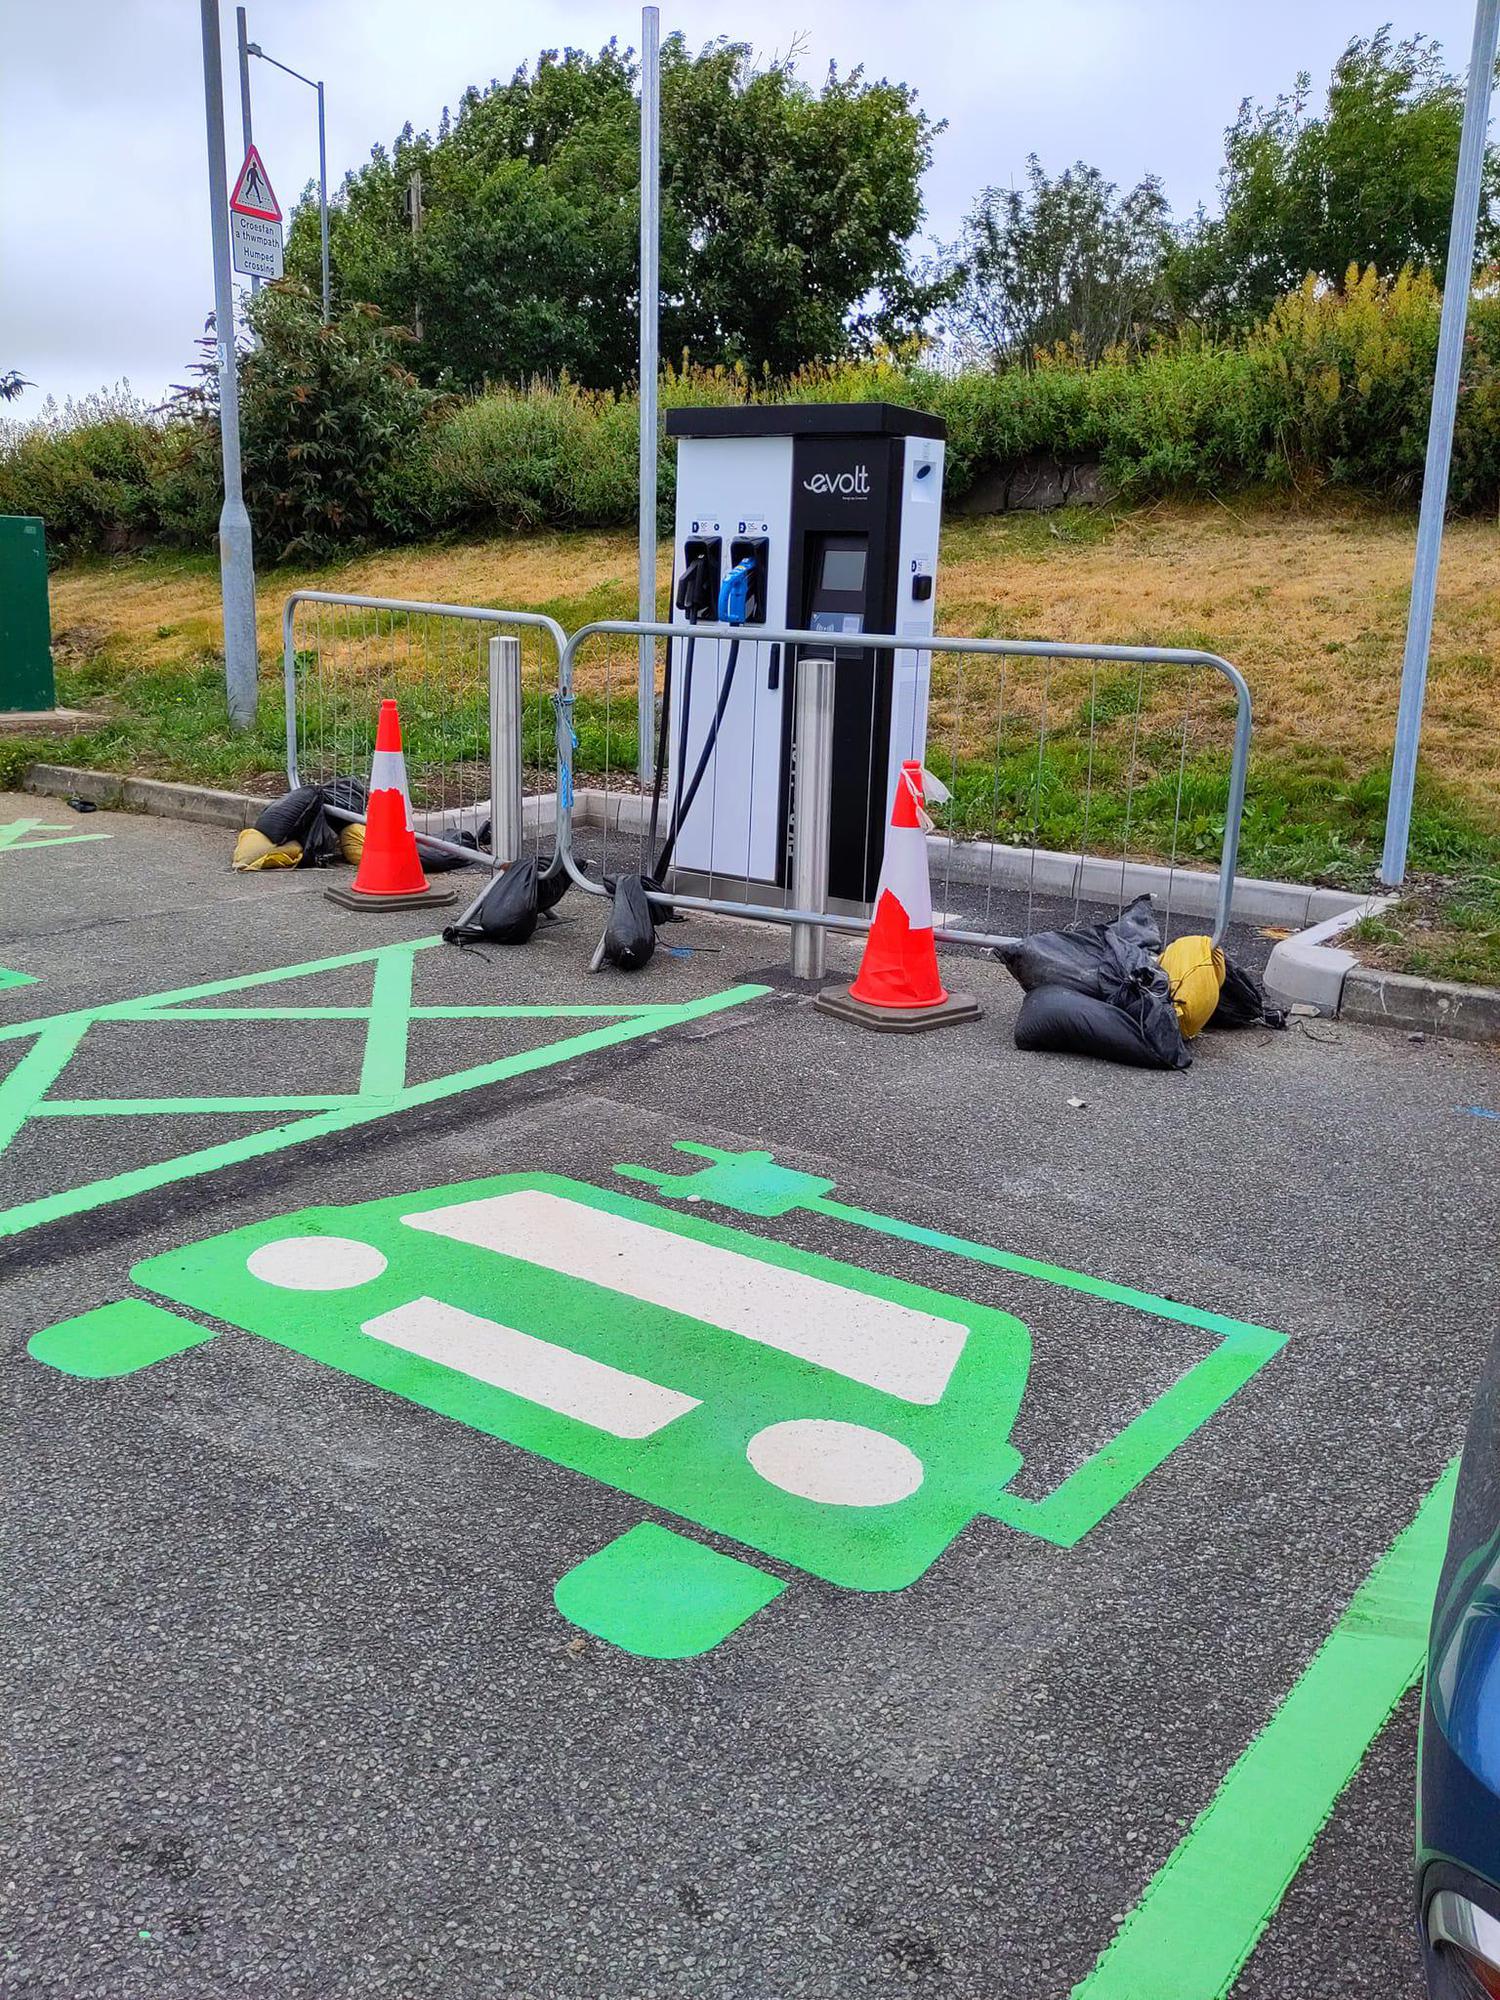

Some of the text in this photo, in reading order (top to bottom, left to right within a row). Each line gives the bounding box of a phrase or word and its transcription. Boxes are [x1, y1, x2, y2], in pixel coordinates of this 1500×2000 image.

[240, 218, 275, 235] Croesfan
[235, 230, 280, 249] a thwmpath
[243, 246, 275, 263] Humped
[244, 260, 275, 276] crossing
[803, 465, 870, 494] evolt
